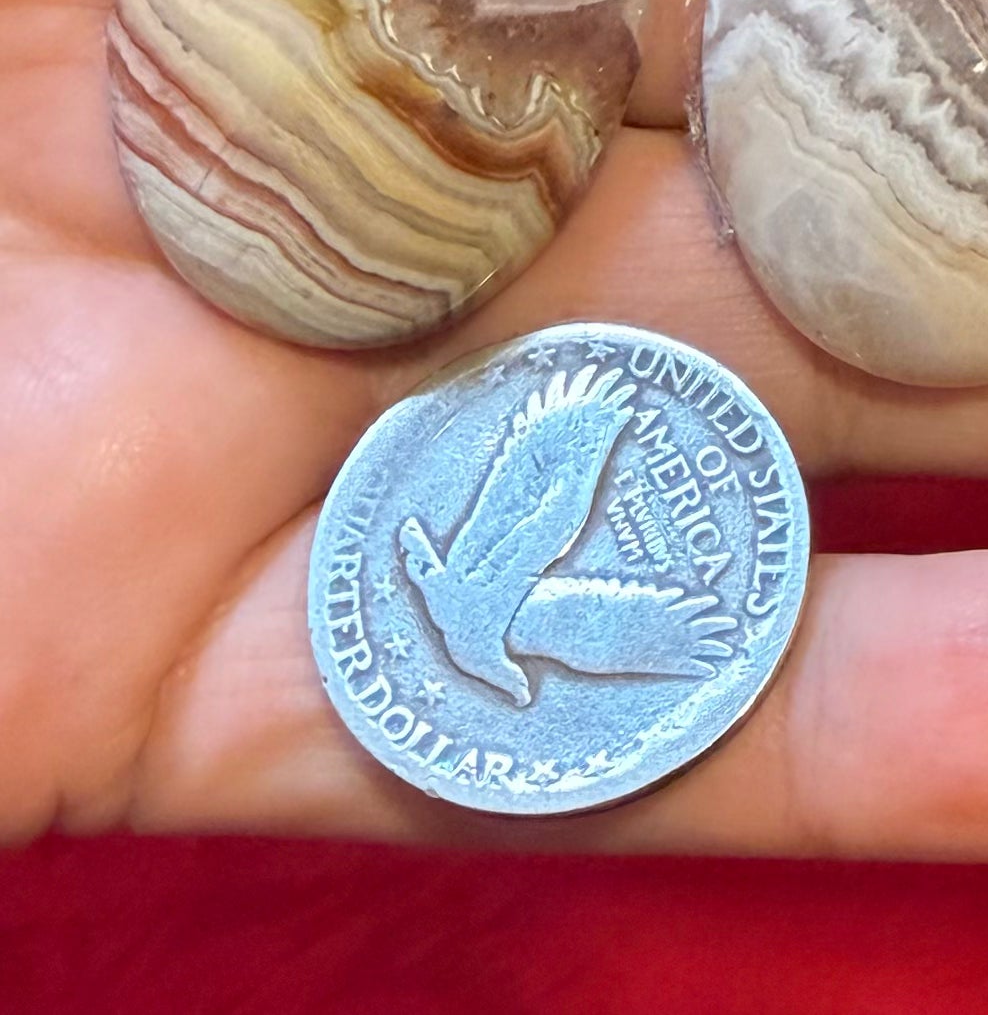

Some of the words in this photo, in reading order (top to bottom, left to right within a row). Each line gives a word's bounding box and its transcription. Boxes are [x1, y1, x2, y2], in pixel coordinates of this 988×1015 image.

[628, 345, 764, 454] UNITED
[746, 459, 794, 617] STATES
[634, 409, 732, 587] AMERICA
[695, 445, 741, 494] OF
[350, 674, 513, 785] DOLLAR
